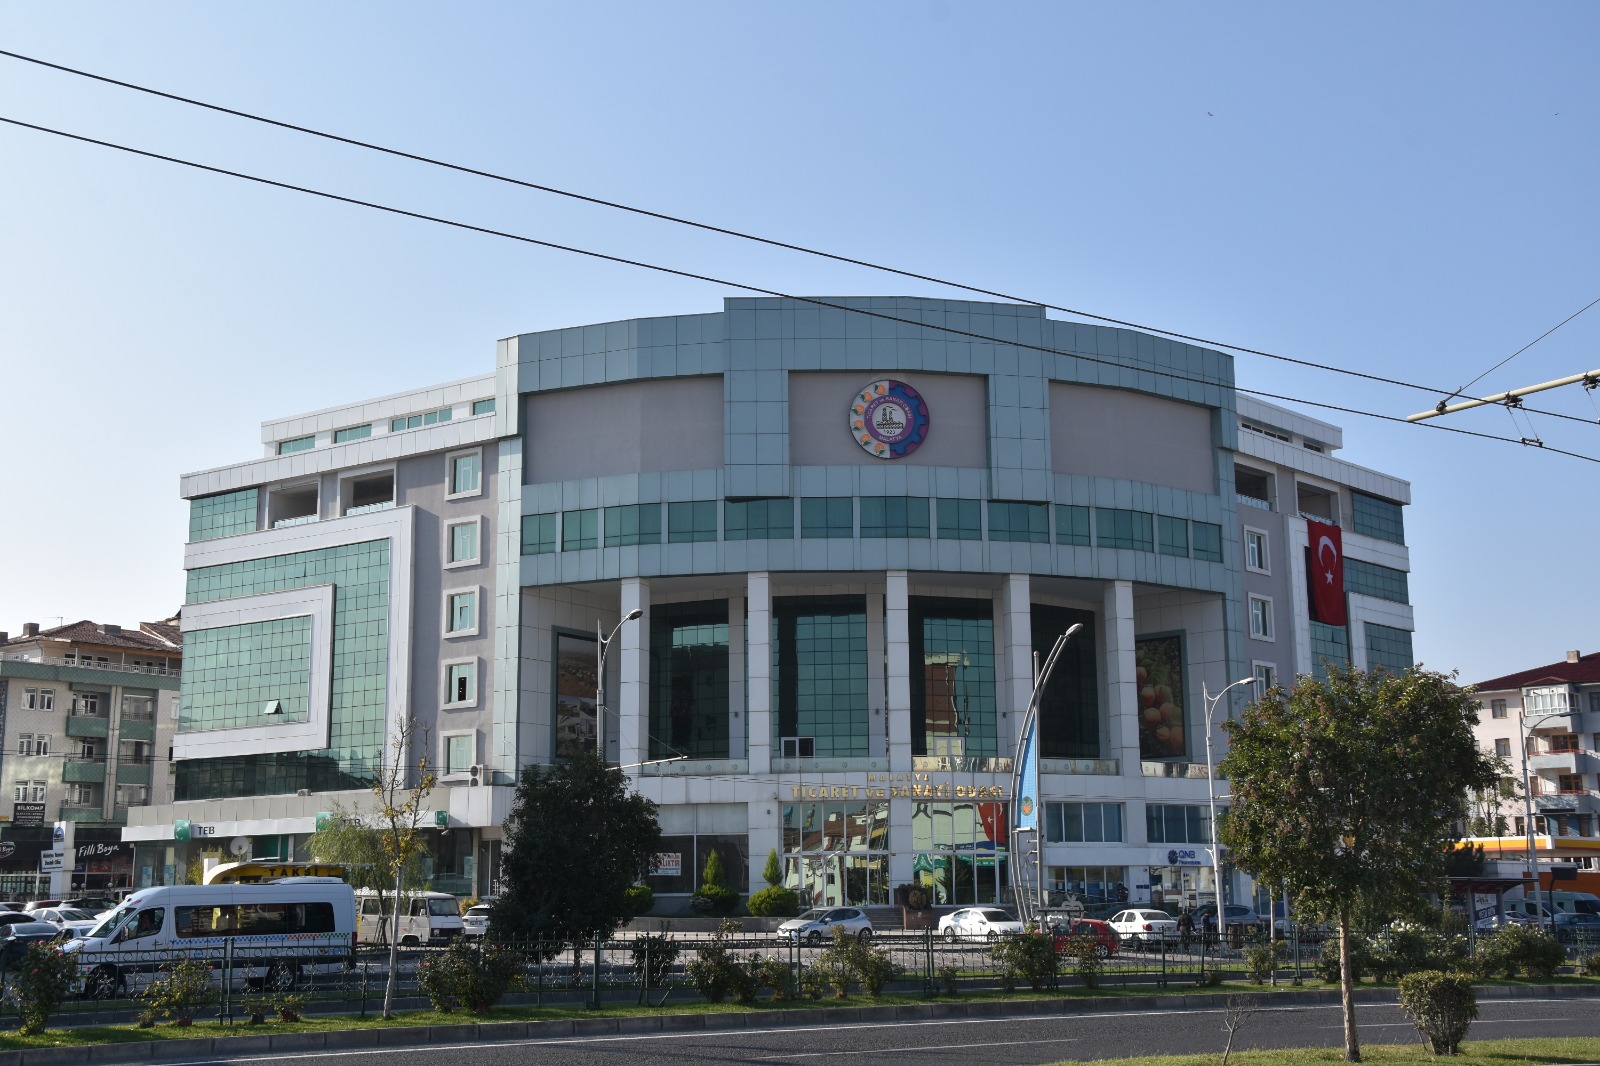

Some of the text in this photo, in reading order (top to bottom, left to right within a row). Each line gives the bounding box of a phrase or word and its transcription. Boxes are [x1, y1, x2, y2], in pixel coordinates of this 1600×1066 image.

[868, 773, 930, 782] MALATYA
[791, 782, 1003, 798] TİCARET ve SANAYİ ODASI
[197, 826, 216, 836] TEB
[78, 844, 96, 857] Filli
[96, 843, 120, 856] Boya
[1178, 850, 1196, 859] QNB
